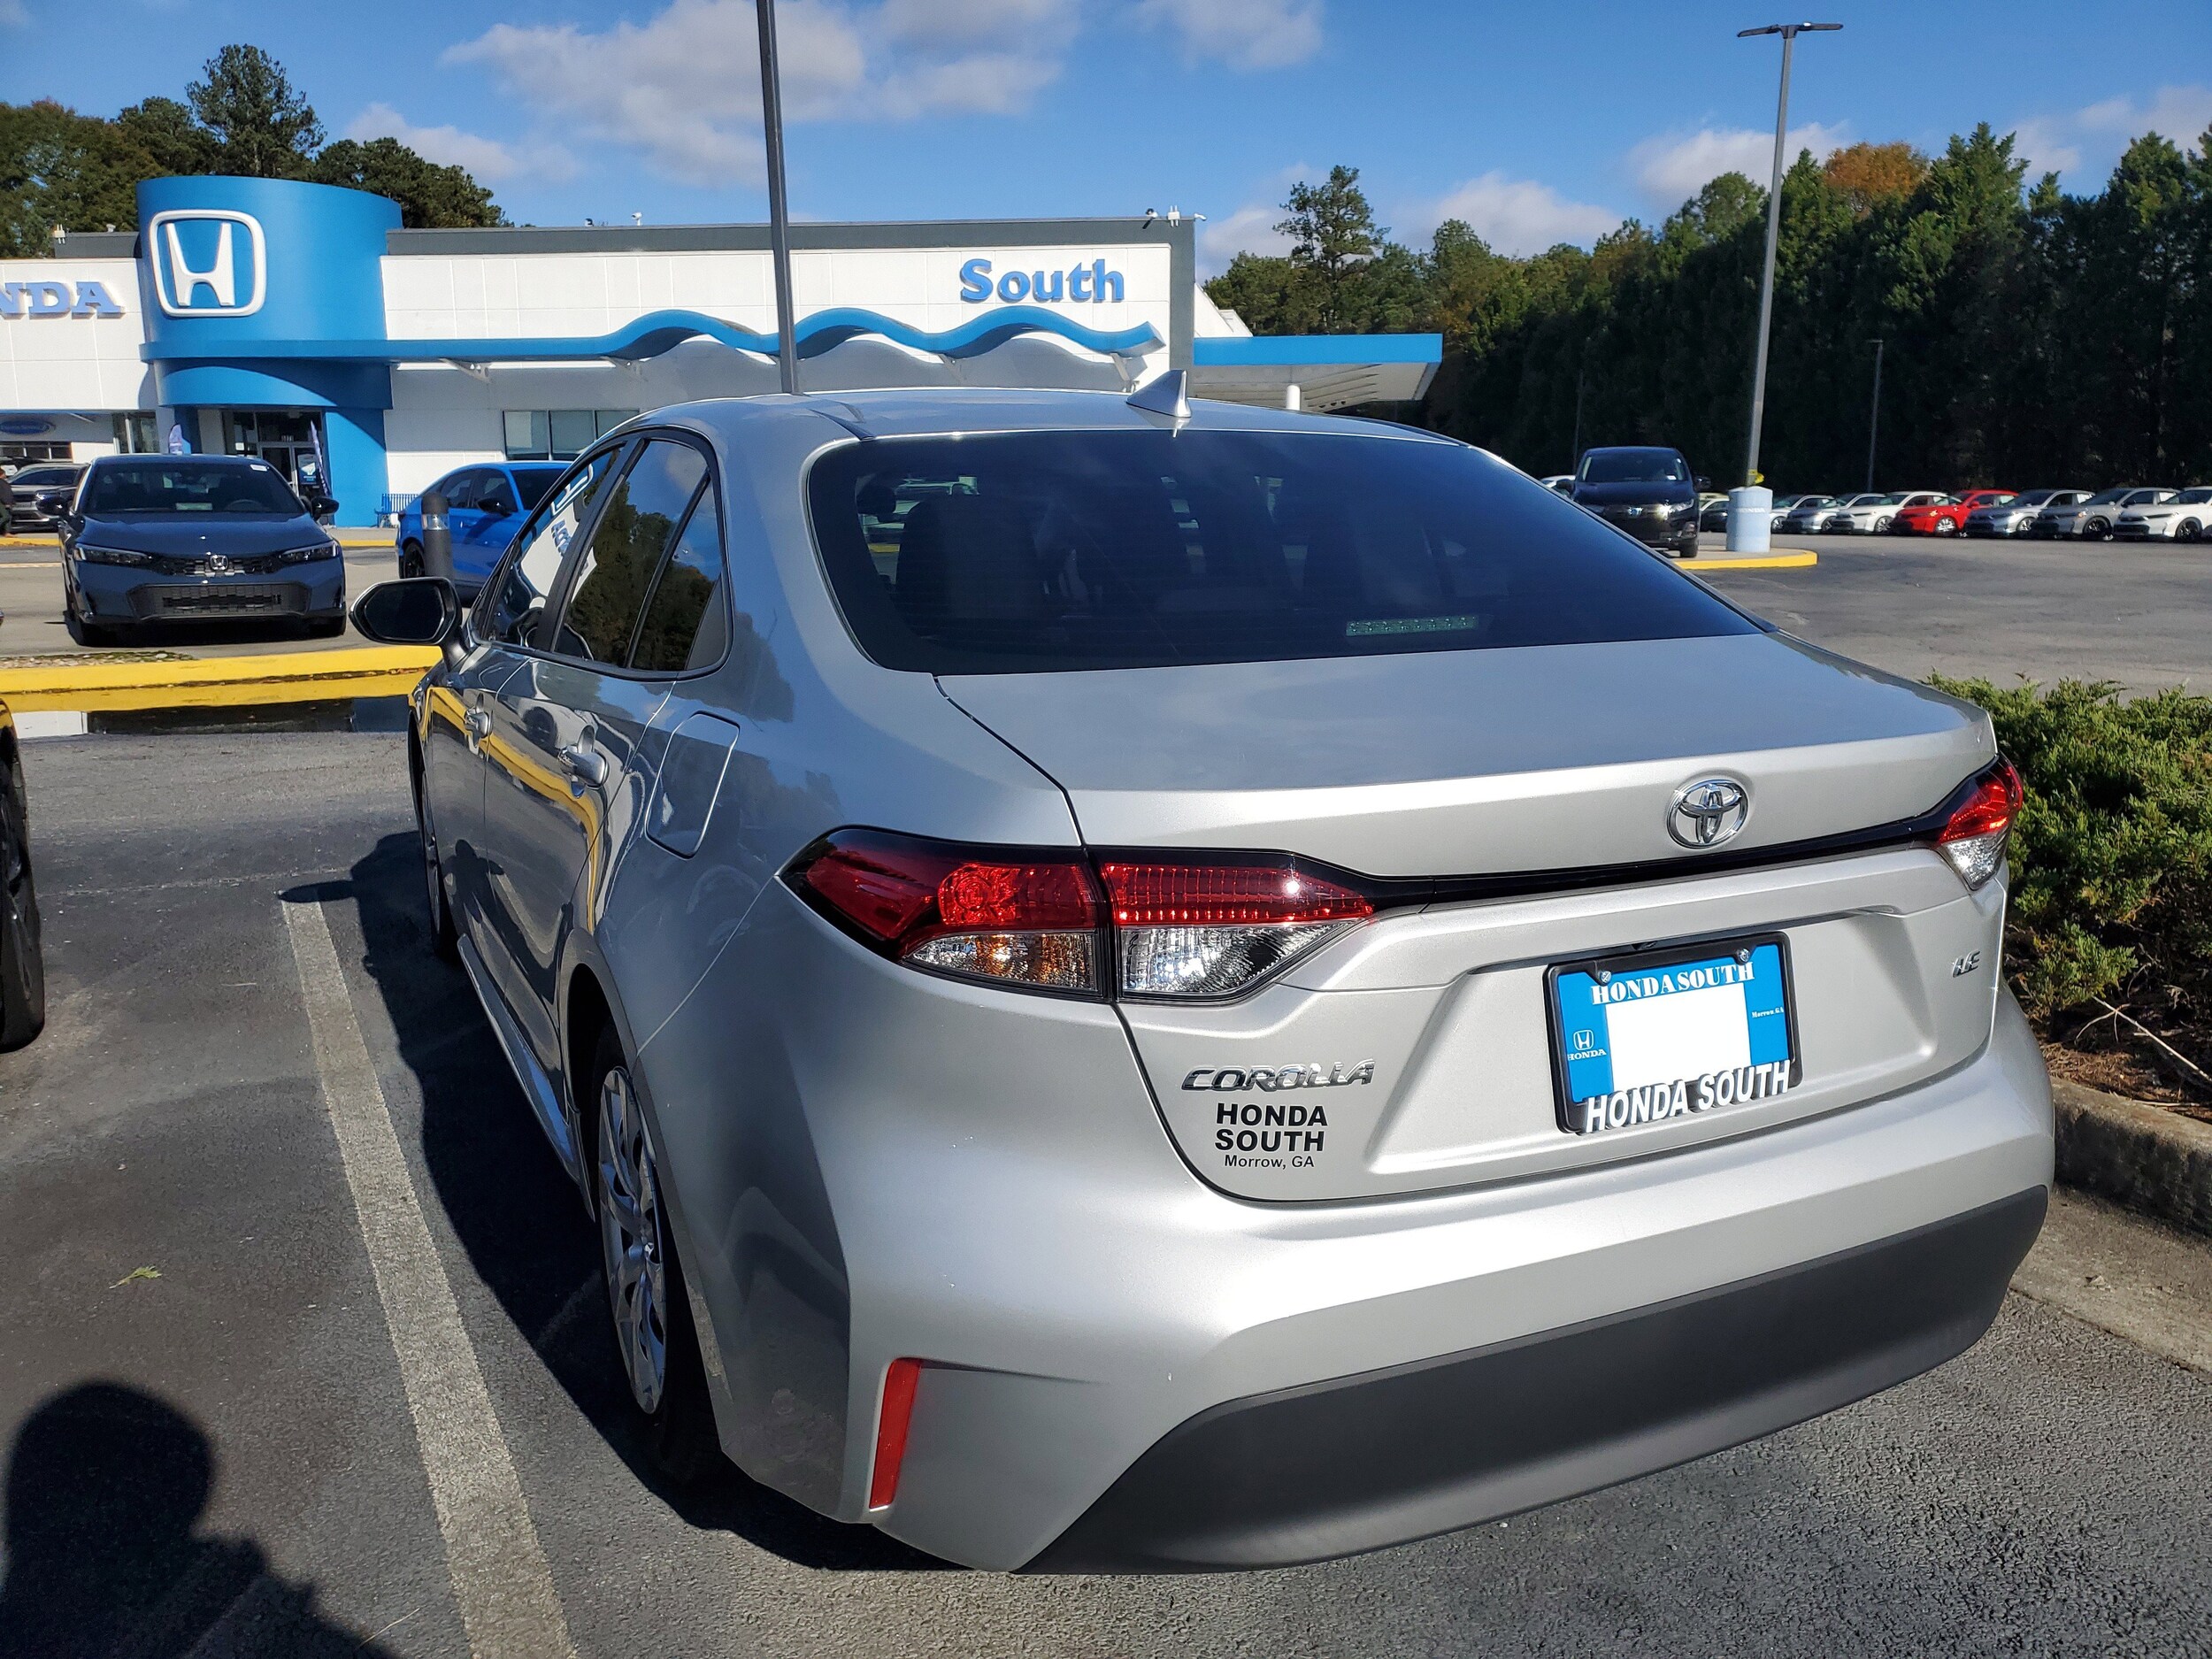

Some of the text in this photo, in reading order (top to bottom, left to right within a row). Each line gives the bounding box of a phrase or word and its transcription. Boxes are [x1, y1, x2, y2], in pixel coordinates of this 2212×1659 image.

[960, 258, 1125, 303] South
[1591, 962, 1755, 1005] HONDA SOUTH
[1567, 1048, 1607, 1062] HONDA
[1181, 1058, 1375, 1092] COROLLA
[1586, 1059, 1791, 1133] HONDA SOUTH
[1216, 1102, 1328, 1126] HONDA
[1215, 1129, 1325, 1152] SOUTH
[1225, 1155, 1315, 1169] Morrow, GA
